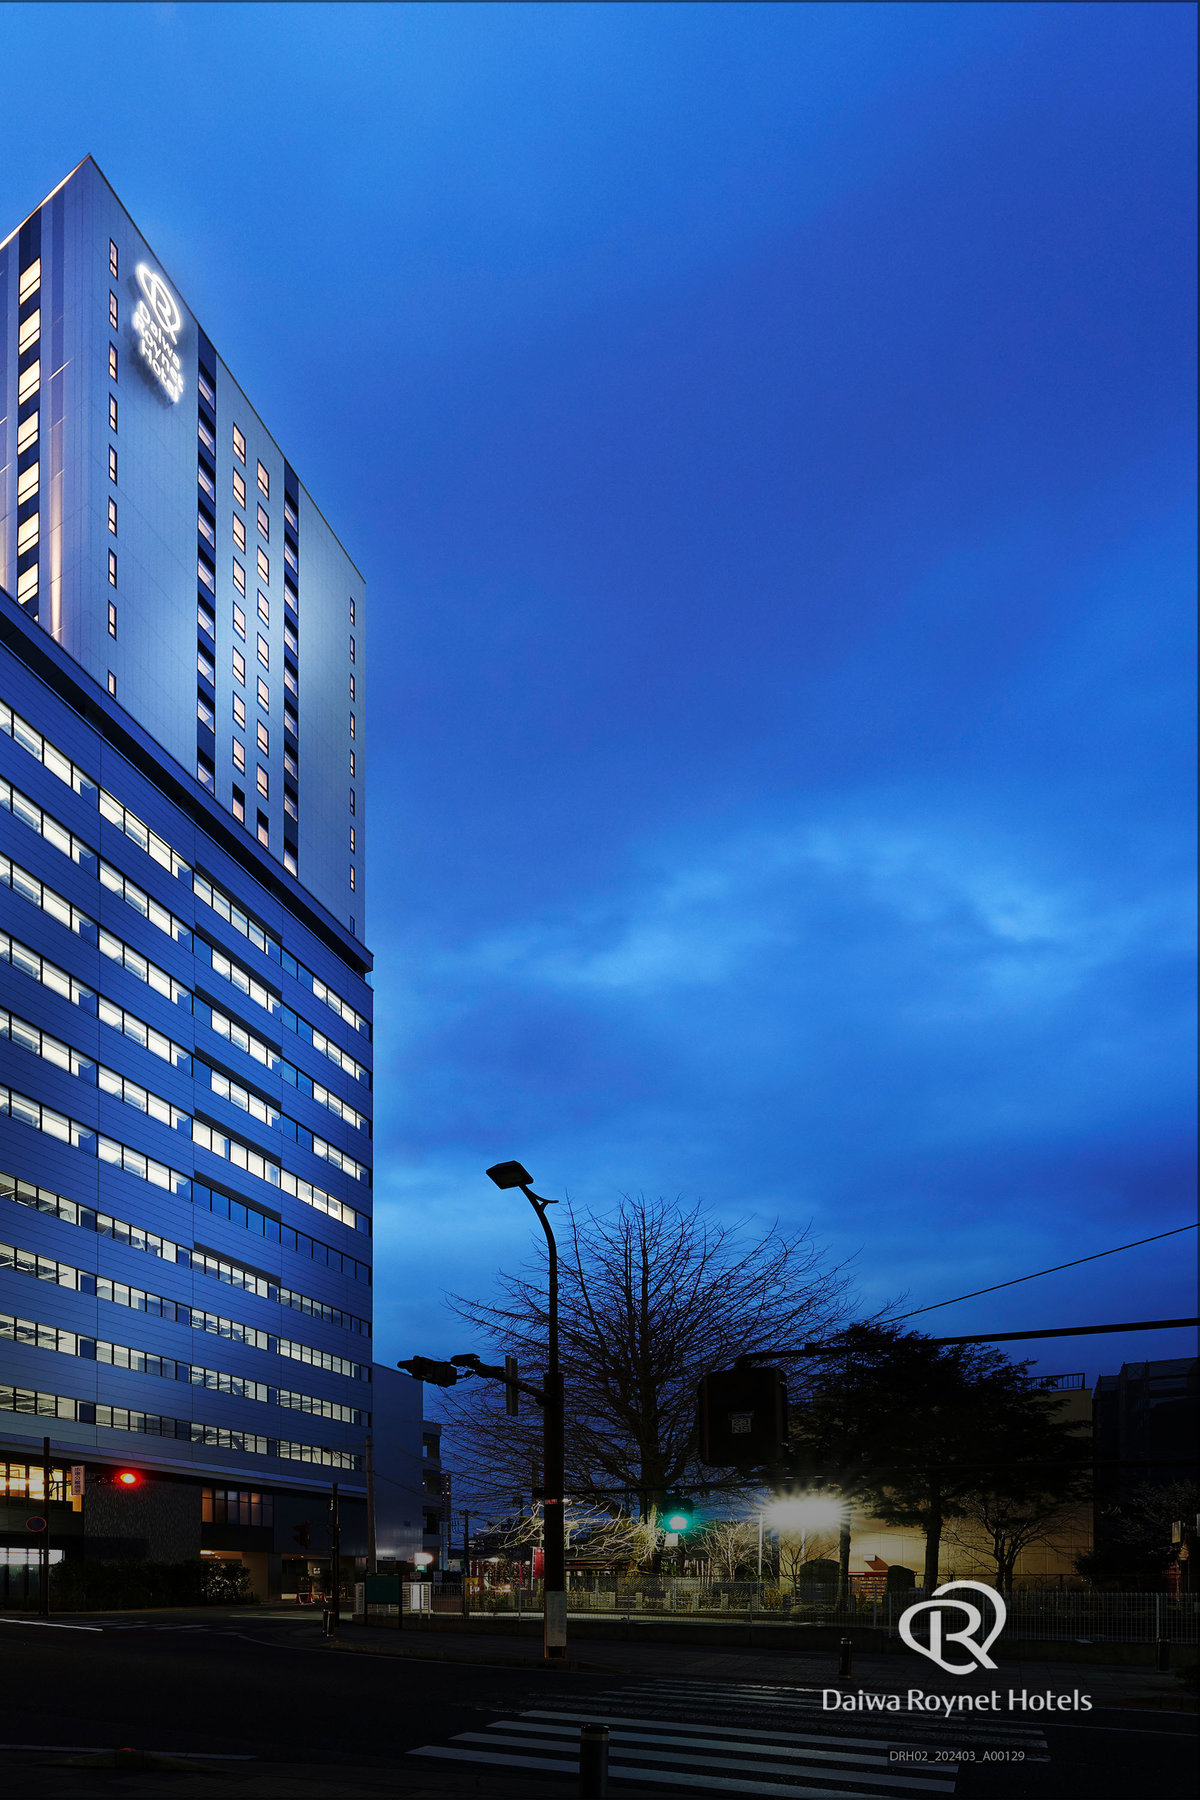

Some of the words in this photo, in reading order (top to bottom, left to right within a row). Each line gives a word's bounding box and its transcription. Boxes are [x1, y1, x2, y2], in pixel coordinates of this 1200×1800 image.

[133, 311, 183, 392] Roynet
[139, 300, 180, 369] Daiwa
[141, 342, 179, 403] Hotel
